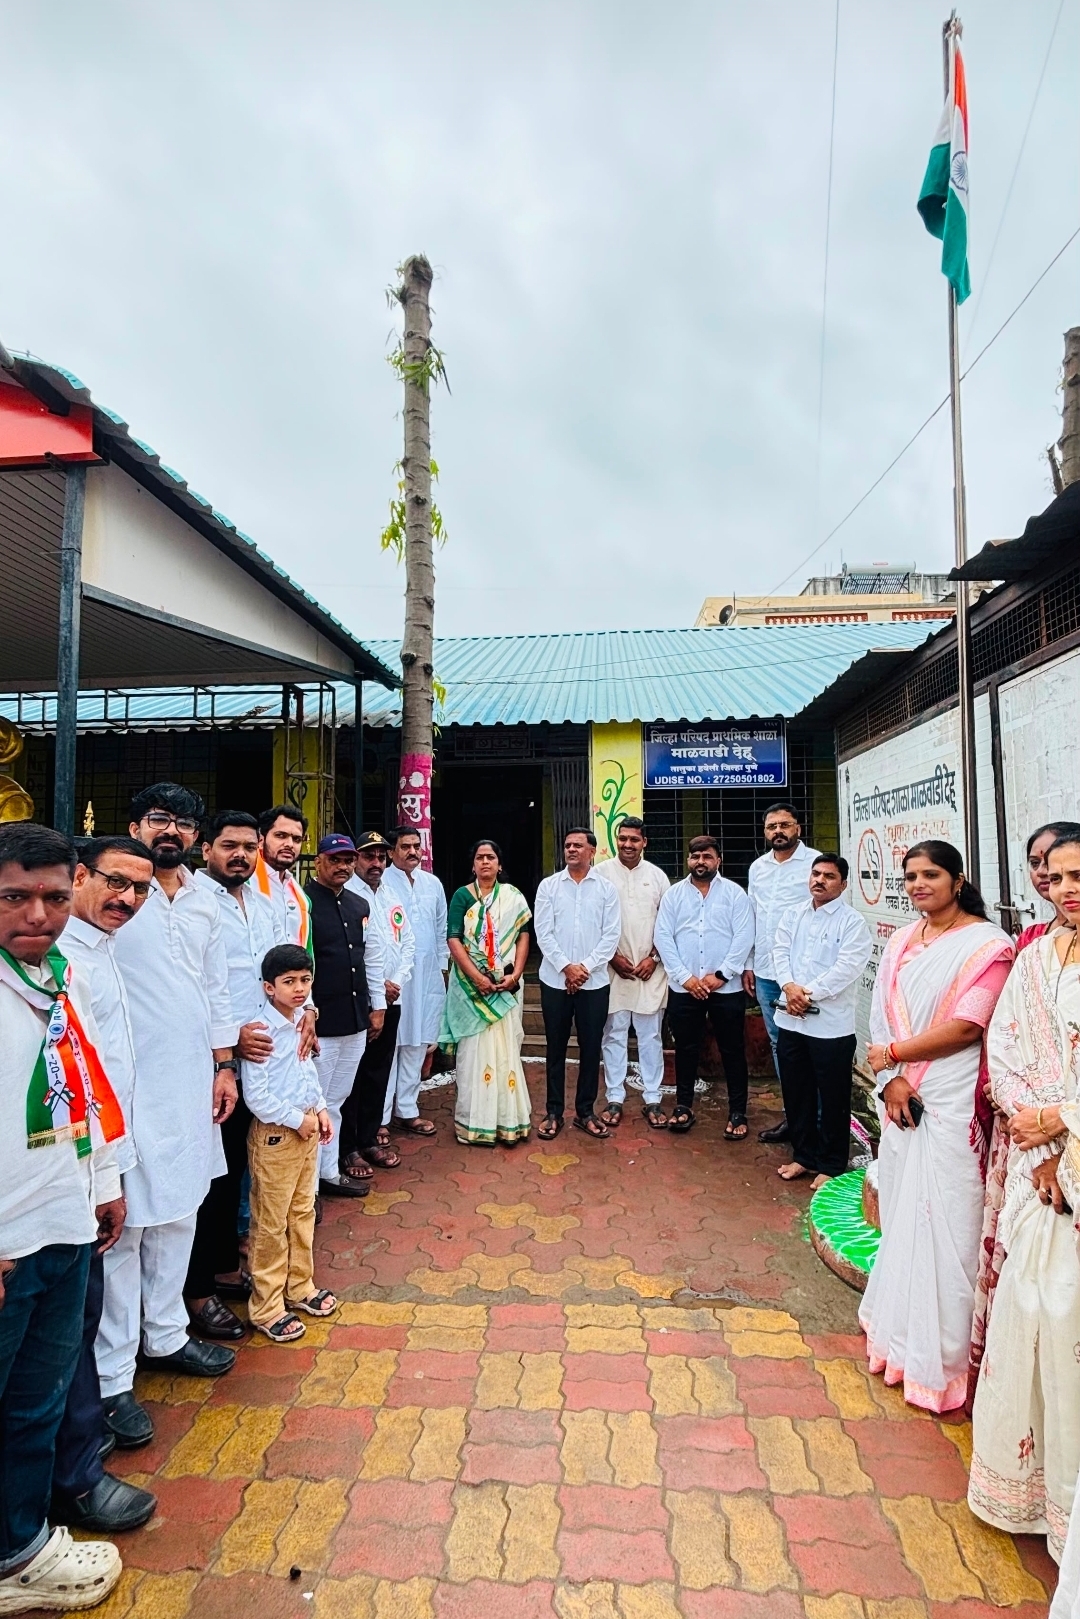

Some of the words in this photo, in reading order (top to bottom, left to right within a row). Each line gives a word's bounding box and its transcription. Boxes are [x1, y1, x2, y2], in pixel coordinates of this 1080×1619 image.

[650, 729, 678, 745] जिल्हा
[712, 728, 751, 743] प्राथमिक
[753, 730, 777, 741] शाळा
[671, 744, 729, 758] माळवाडी
[732, 743, 757, 761] देहू
[670, 765, 696, 774] तालुका
[721, 764, 743, 772] जिल्हा
[745, 763, 758, 773] पुणे
[655, 776, 684, 784] UDISE
[687, 776, 704, 784] NO.
[713, 774, 775, 783] 27250501802
[853, 792, 871, 822] जिल्हा
[871, 785, 891, 818] परिषद
[891, 785, 910, 815] शाळा
[910, 764, 943, 810] माळवाडी
[943, 763, 957, 812] देहू
[49, 1054, 62, 1087] INDIA
